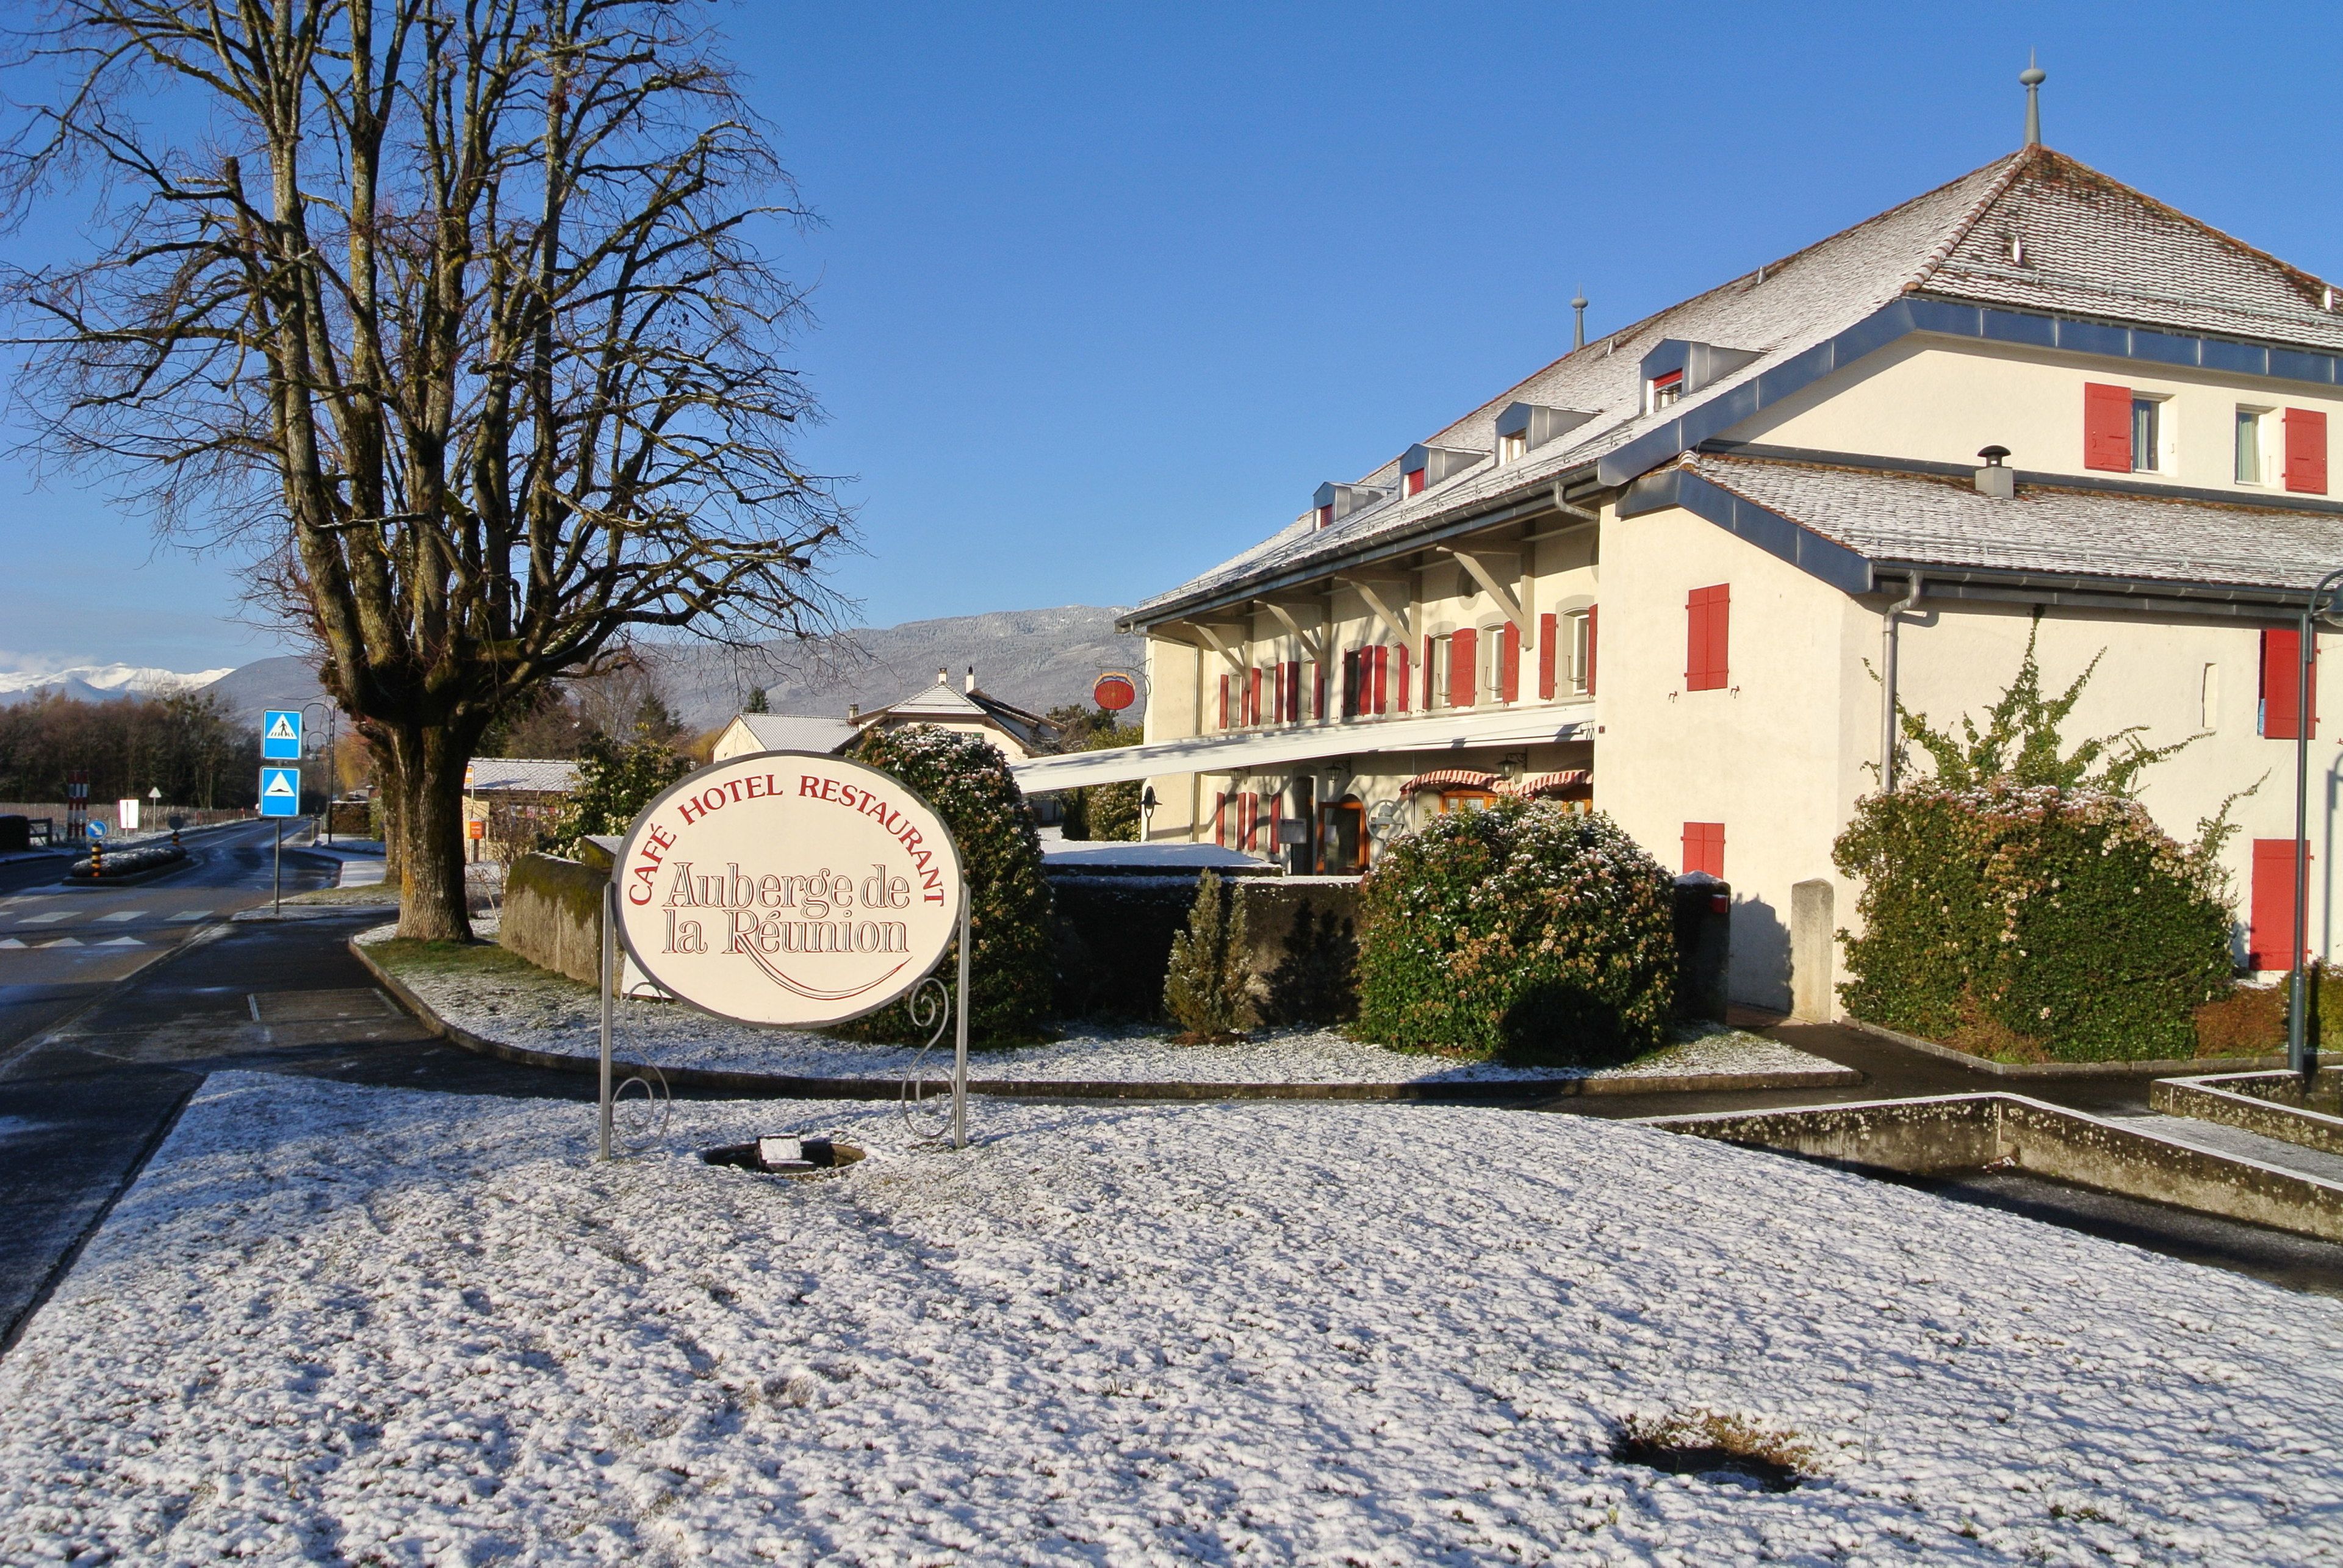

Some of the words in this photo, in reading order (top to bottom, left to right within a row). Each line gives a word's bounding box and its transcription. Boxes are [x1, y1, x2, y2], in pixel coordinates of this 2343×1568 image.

[628, 822, 677, 906] CAFÉ
[677, 774, 783, 825] HOTEL
[798, 775, 945, 907] RESTAURANT
[661, 861, 853, 919] Auberge
[860, 863, 910, 909] de
[661, 908, 708, 954] la
